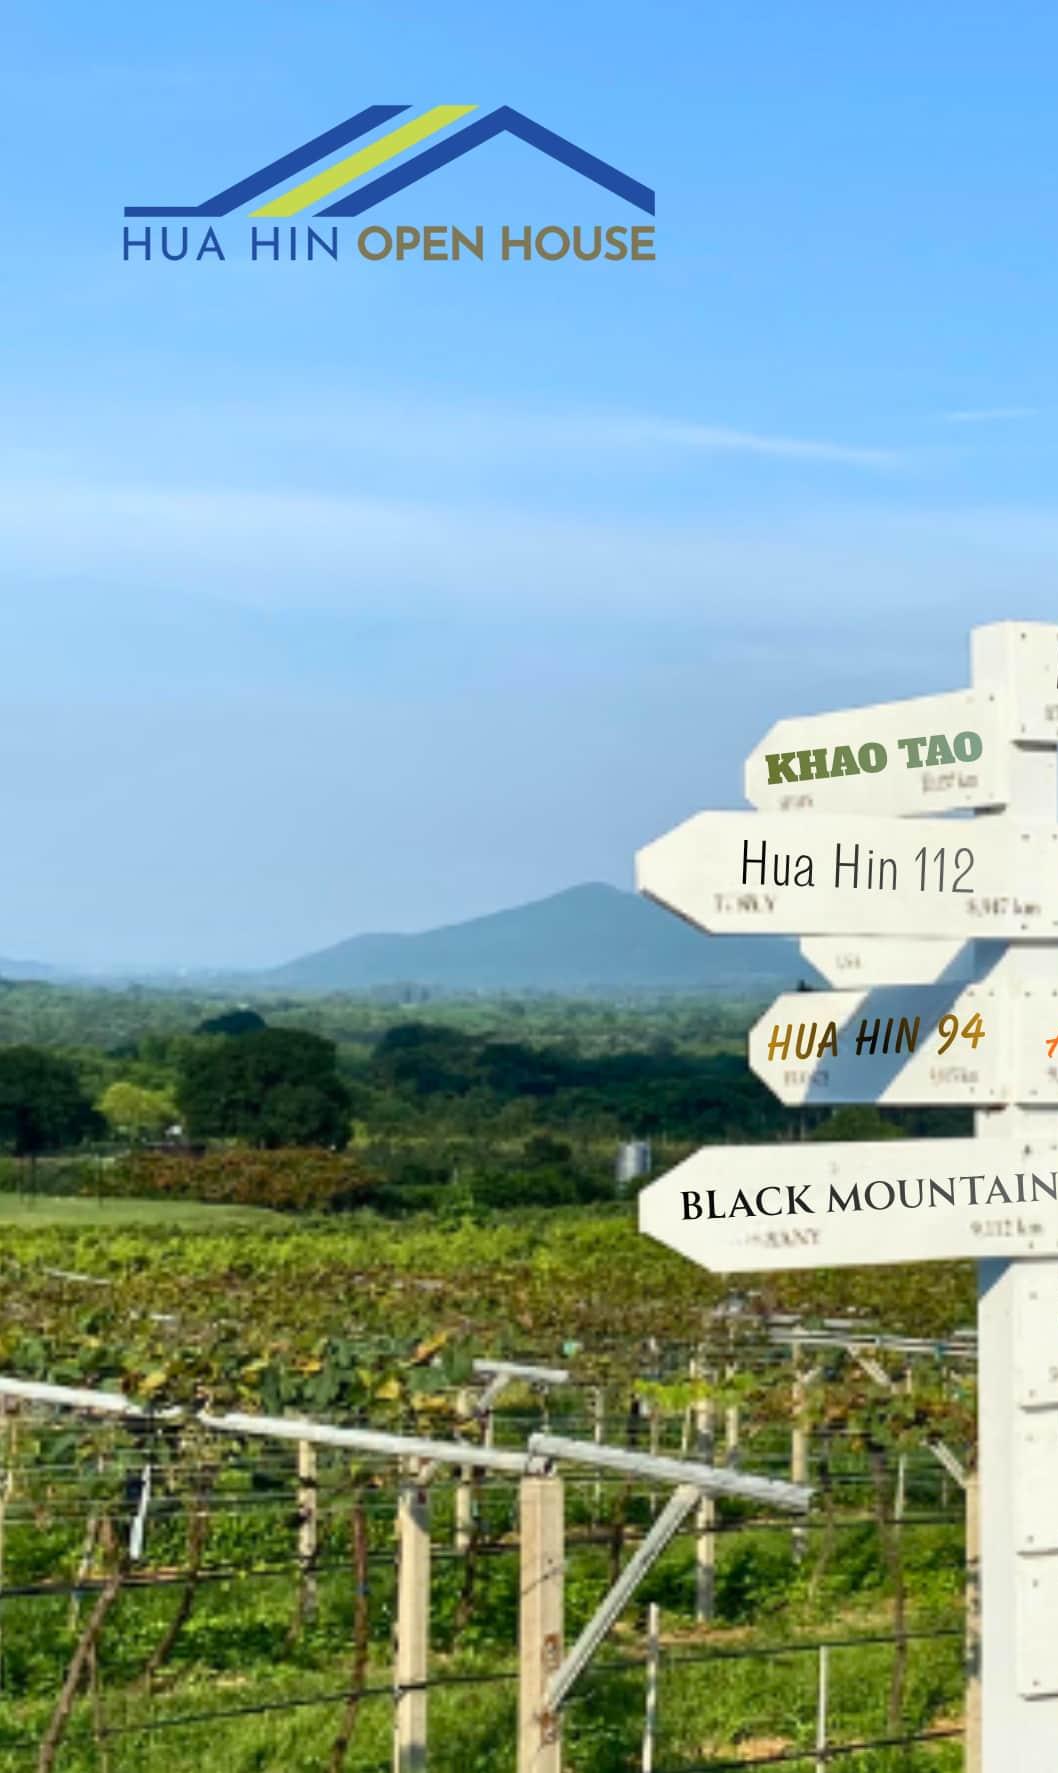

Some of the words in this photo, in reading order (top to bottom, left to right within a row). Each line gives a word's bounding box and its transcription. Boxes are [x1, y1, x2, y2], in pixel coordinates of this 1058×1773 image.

[764, 742, 888, 785] KHAO
[897, 731, 983, 768] TAO
[741, 839, 815, 887] Hua
[834, 843, 897, 890] Hin
[914, 846, 974, 893] 112
[768, 1021, 838, 1061] HUA
[856, 1016, 920, 1056] HIN
[937, 1012, 985, 1055] 94
[680, 1185, 816, 1221] BLACK
[826, 1172, 1058, 1214] MOUNTAIN
